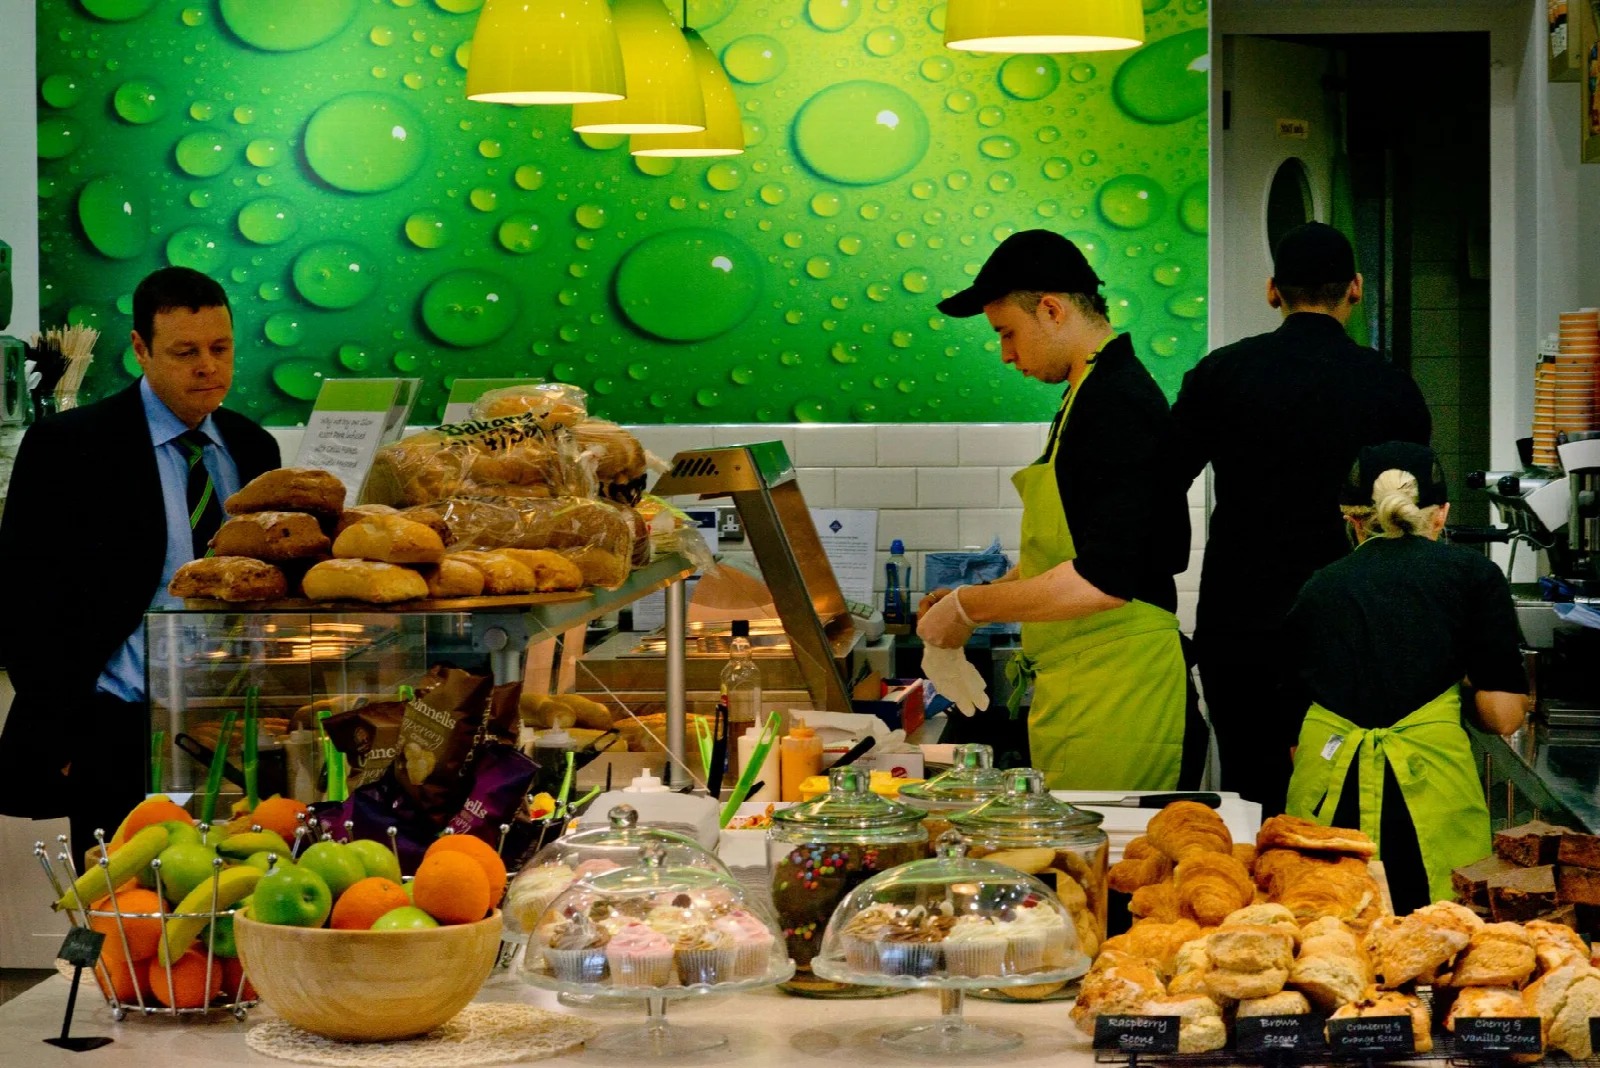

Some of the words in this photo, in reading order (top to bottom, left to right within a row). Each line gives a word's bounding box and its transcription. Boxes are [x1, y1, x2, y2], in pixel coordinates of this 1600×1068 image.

[1108, 1018, 1168, 1033] Raspberry
[1260, 1018, 1300, 1028] Brown
[1346, 1022, 1393, 1033] Cranberry
[1474, 1019, 1511, 1032] Cherry
[1119, 1034, 1155, 1045] Scone
[1264, 1034, 1299, 1045] Scone
[1377, 1034, 1404, 1043] Scone
[1460, 1031, 1501, 1043] Vanilla
[1502, 1034, 1537, 1043] Scone
